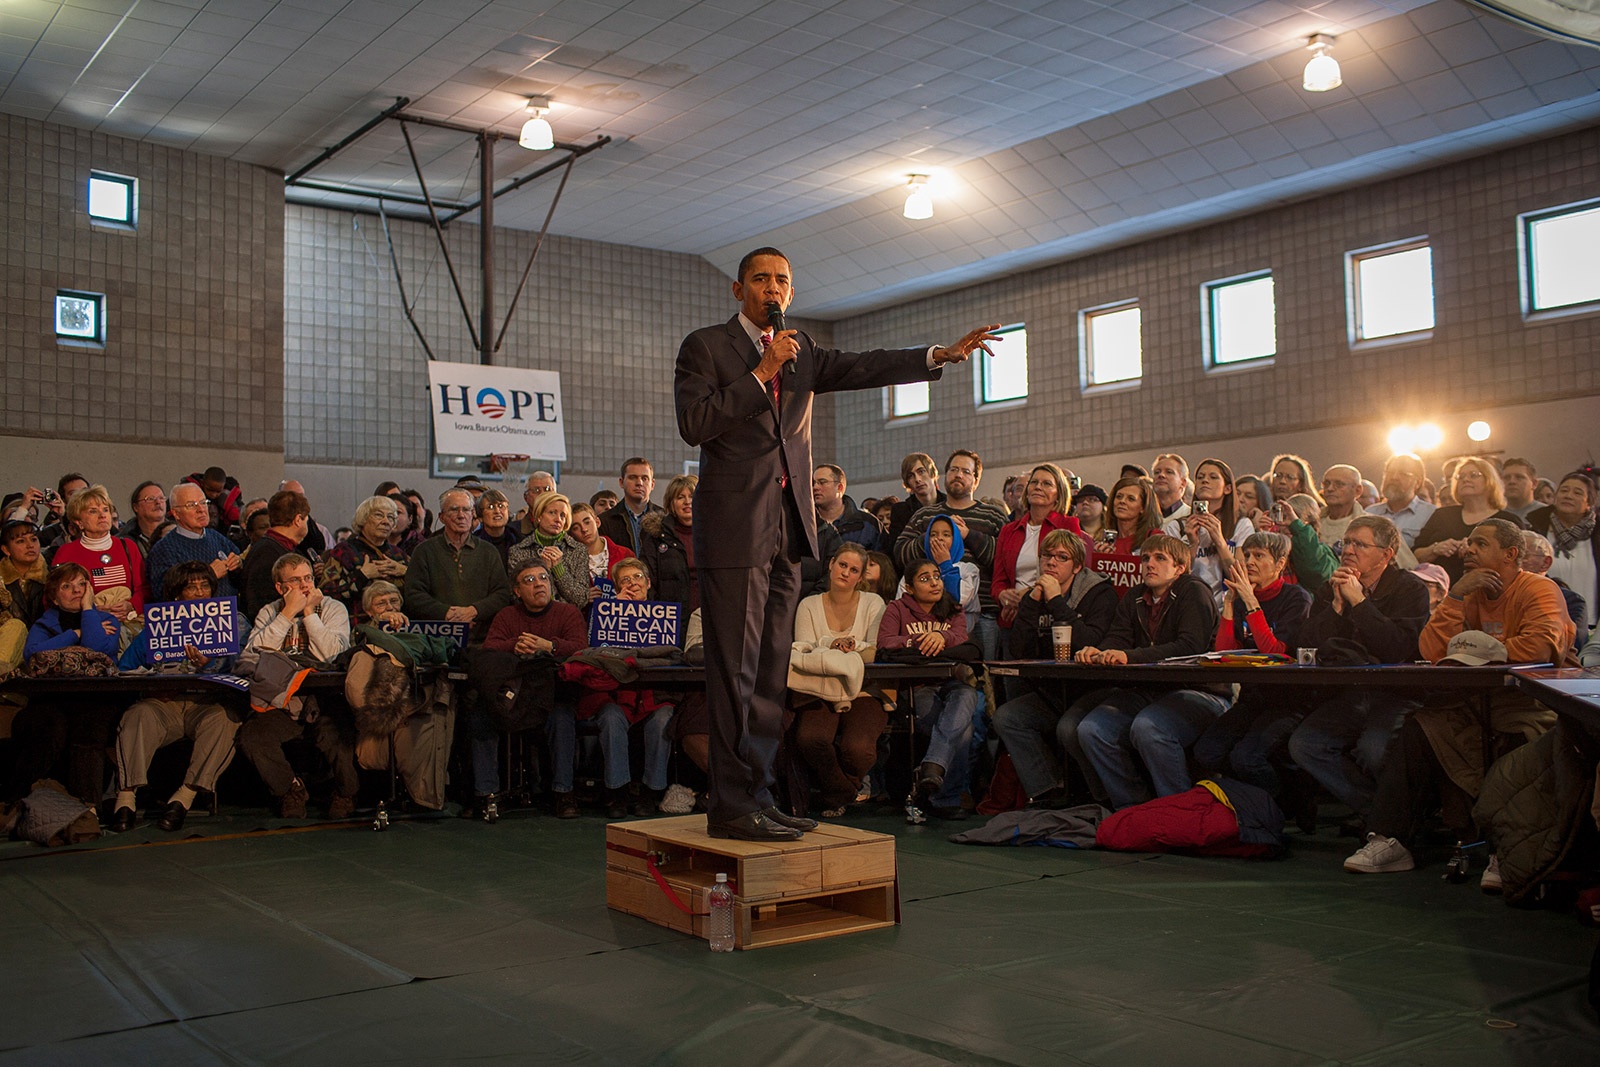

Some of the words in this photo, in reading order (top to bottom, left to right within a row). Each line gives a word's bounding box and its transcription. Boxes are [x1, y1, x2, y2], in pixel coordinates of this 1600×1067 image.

[438, 383, 557, 423] HOPE
[455, 422, 546, 437] Iowa.BarackObama.com
[1097, 559, 1136, 573] STAND
[1108, 572, 1145, 588] HAN
[148, 600, 232, 622] CHANGE
[598, 601, 677, 620] CHANGE
[149, 620, 183, 637] WE
[188, 616, 232, 634] CAN
[598, 616, 630, 632] WE
[635, 618, 676, 634] CAN
[150, 633, 213, 650] BELIEVE
[218, 631, 233, 644] IN
[597, 630, 657, 644] BELIEVE
[661, 634, 676, 645] IN
